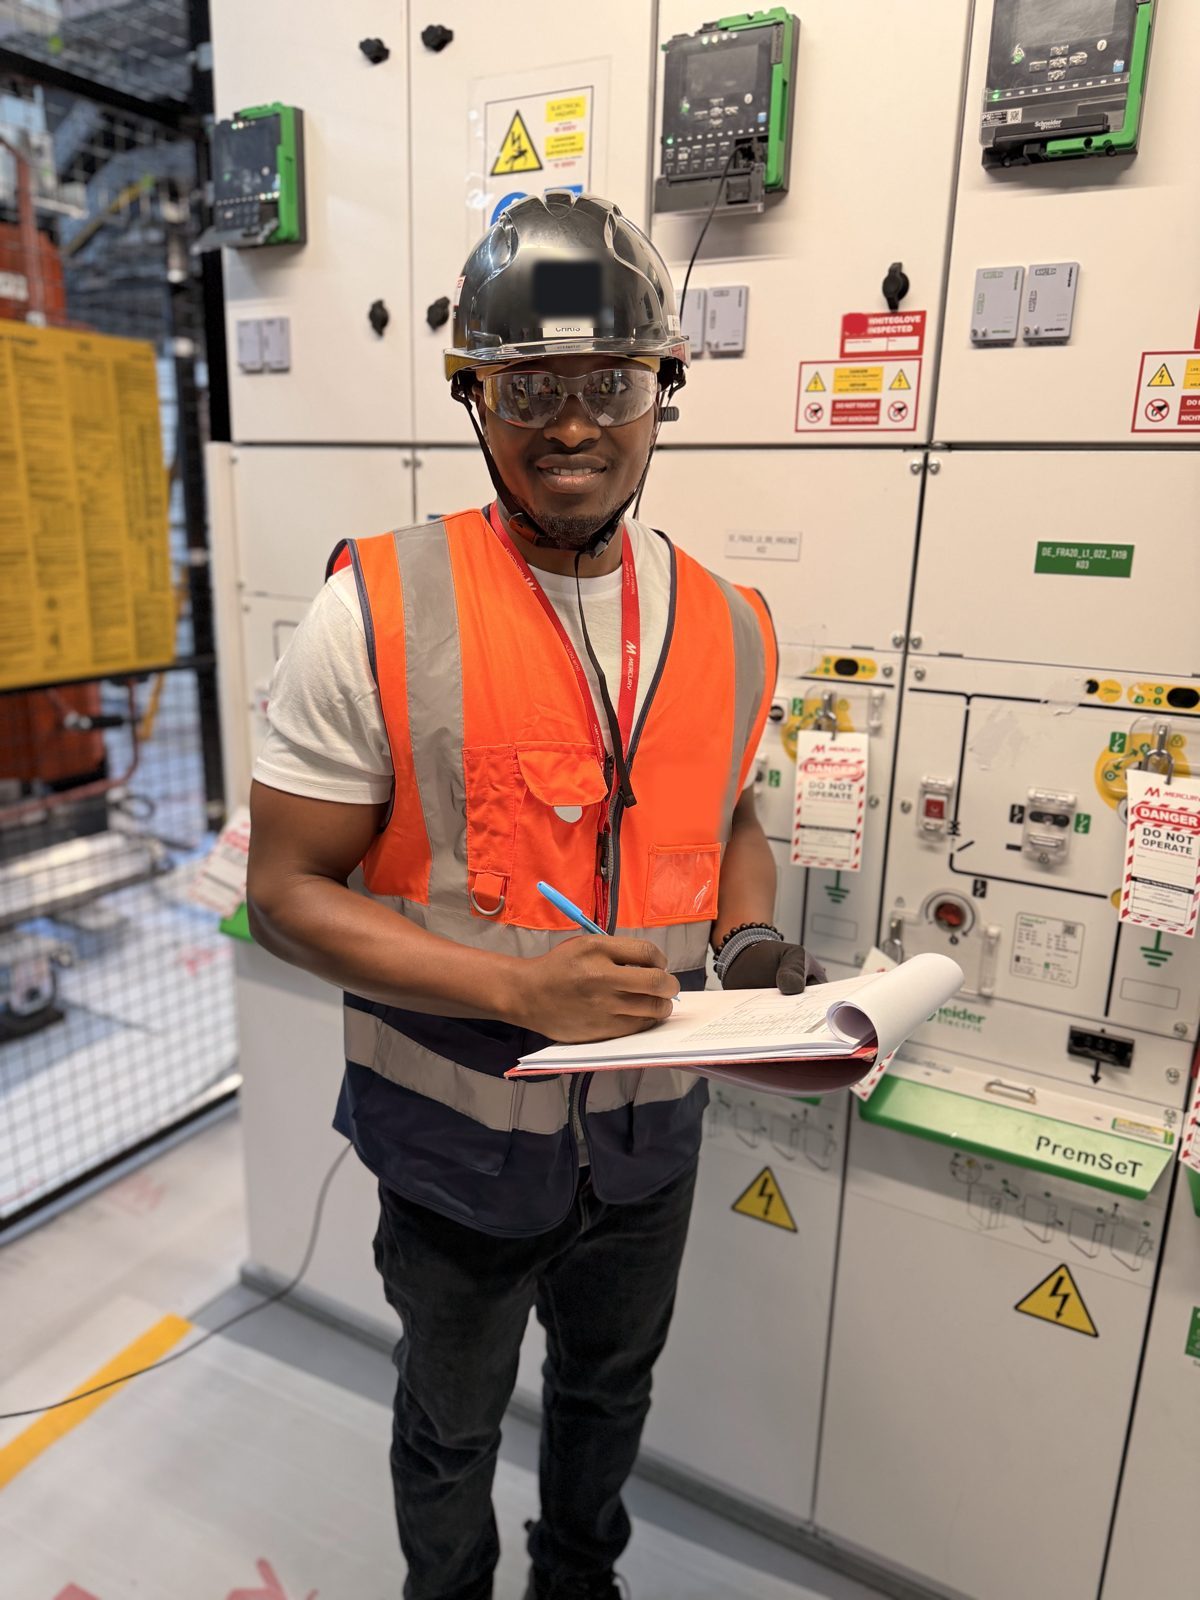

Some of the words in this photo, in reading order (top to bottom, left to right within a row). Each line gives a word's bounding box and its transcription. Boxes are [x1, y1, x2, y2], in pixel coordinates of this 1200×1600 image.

[626, 655, 634, 691] MERCURY
[594, 723, 604, 759] MERCURY
[808, 781, 826, 790] DO
[829, 783, 853, 792] NOT
[808, 790, 852, 800] OPERATE
[1163, 791, 1200, 802] MERCUR
[1141, 807, 1199, 827] DANGER
[1143, 828, 1162, 839] DO
[1166, 832, 1195, 845] NOT
[1142, 838, 1193, 855] OPERATE
[938, 1006, 986, 1024] eider
